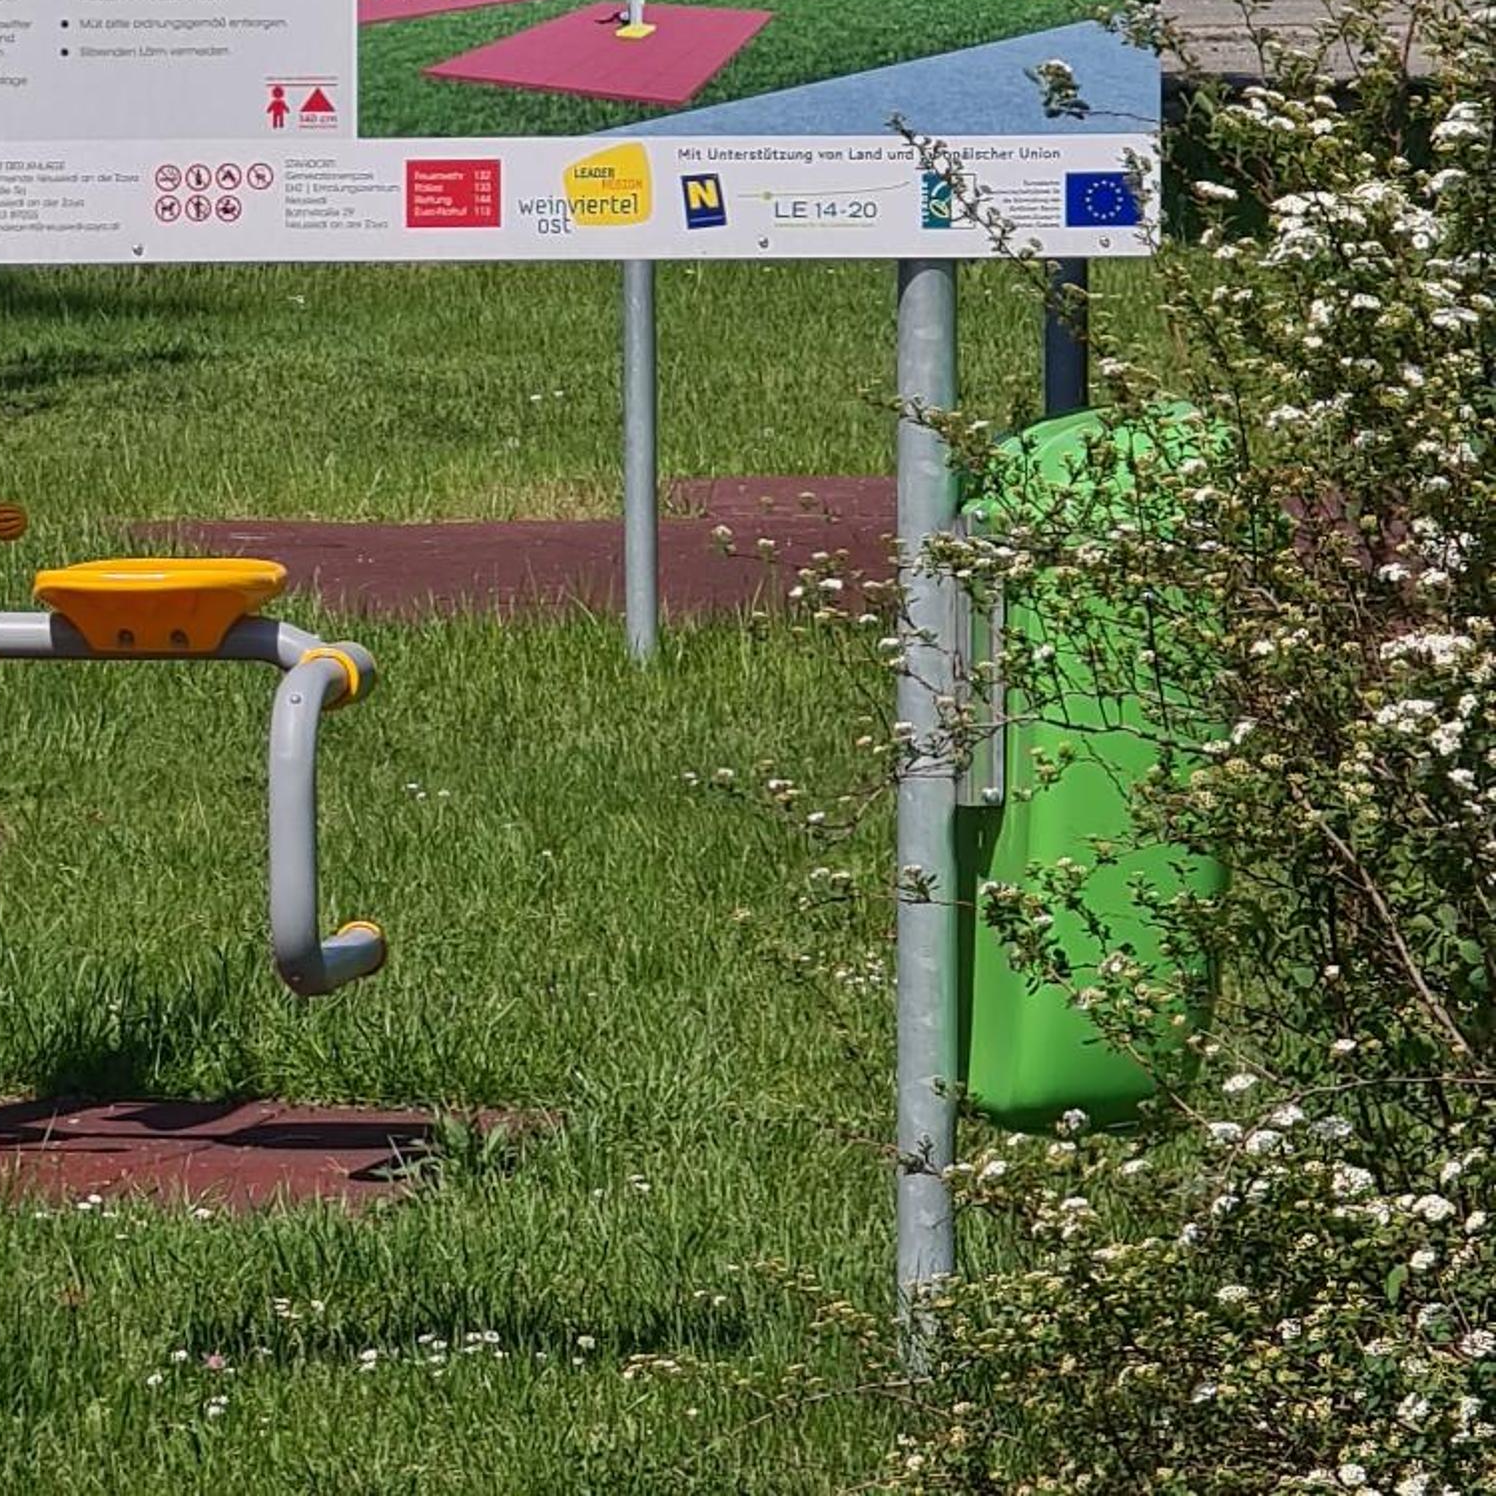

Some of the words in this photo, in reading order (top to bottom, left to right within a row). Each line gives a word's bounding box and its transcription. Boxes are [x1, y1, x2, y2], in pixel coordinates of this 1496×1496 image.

[678, 149, 701, 160] Mit
[707, 148, 813, 163] Unterstützung
[819, 150, 842, 160] von
[848, 148, 882, 160] Land
[887, 148, 914, 160] und
[1019, 148, 1061, 160] Union
[574, 167, 615, 179] LEADER
[519, 194, 638, 215] weinviertel
[775, 201, 808, 218] LE
[816, 201, 877, 218] 14-20
[538, 216, 571, 234] ost
